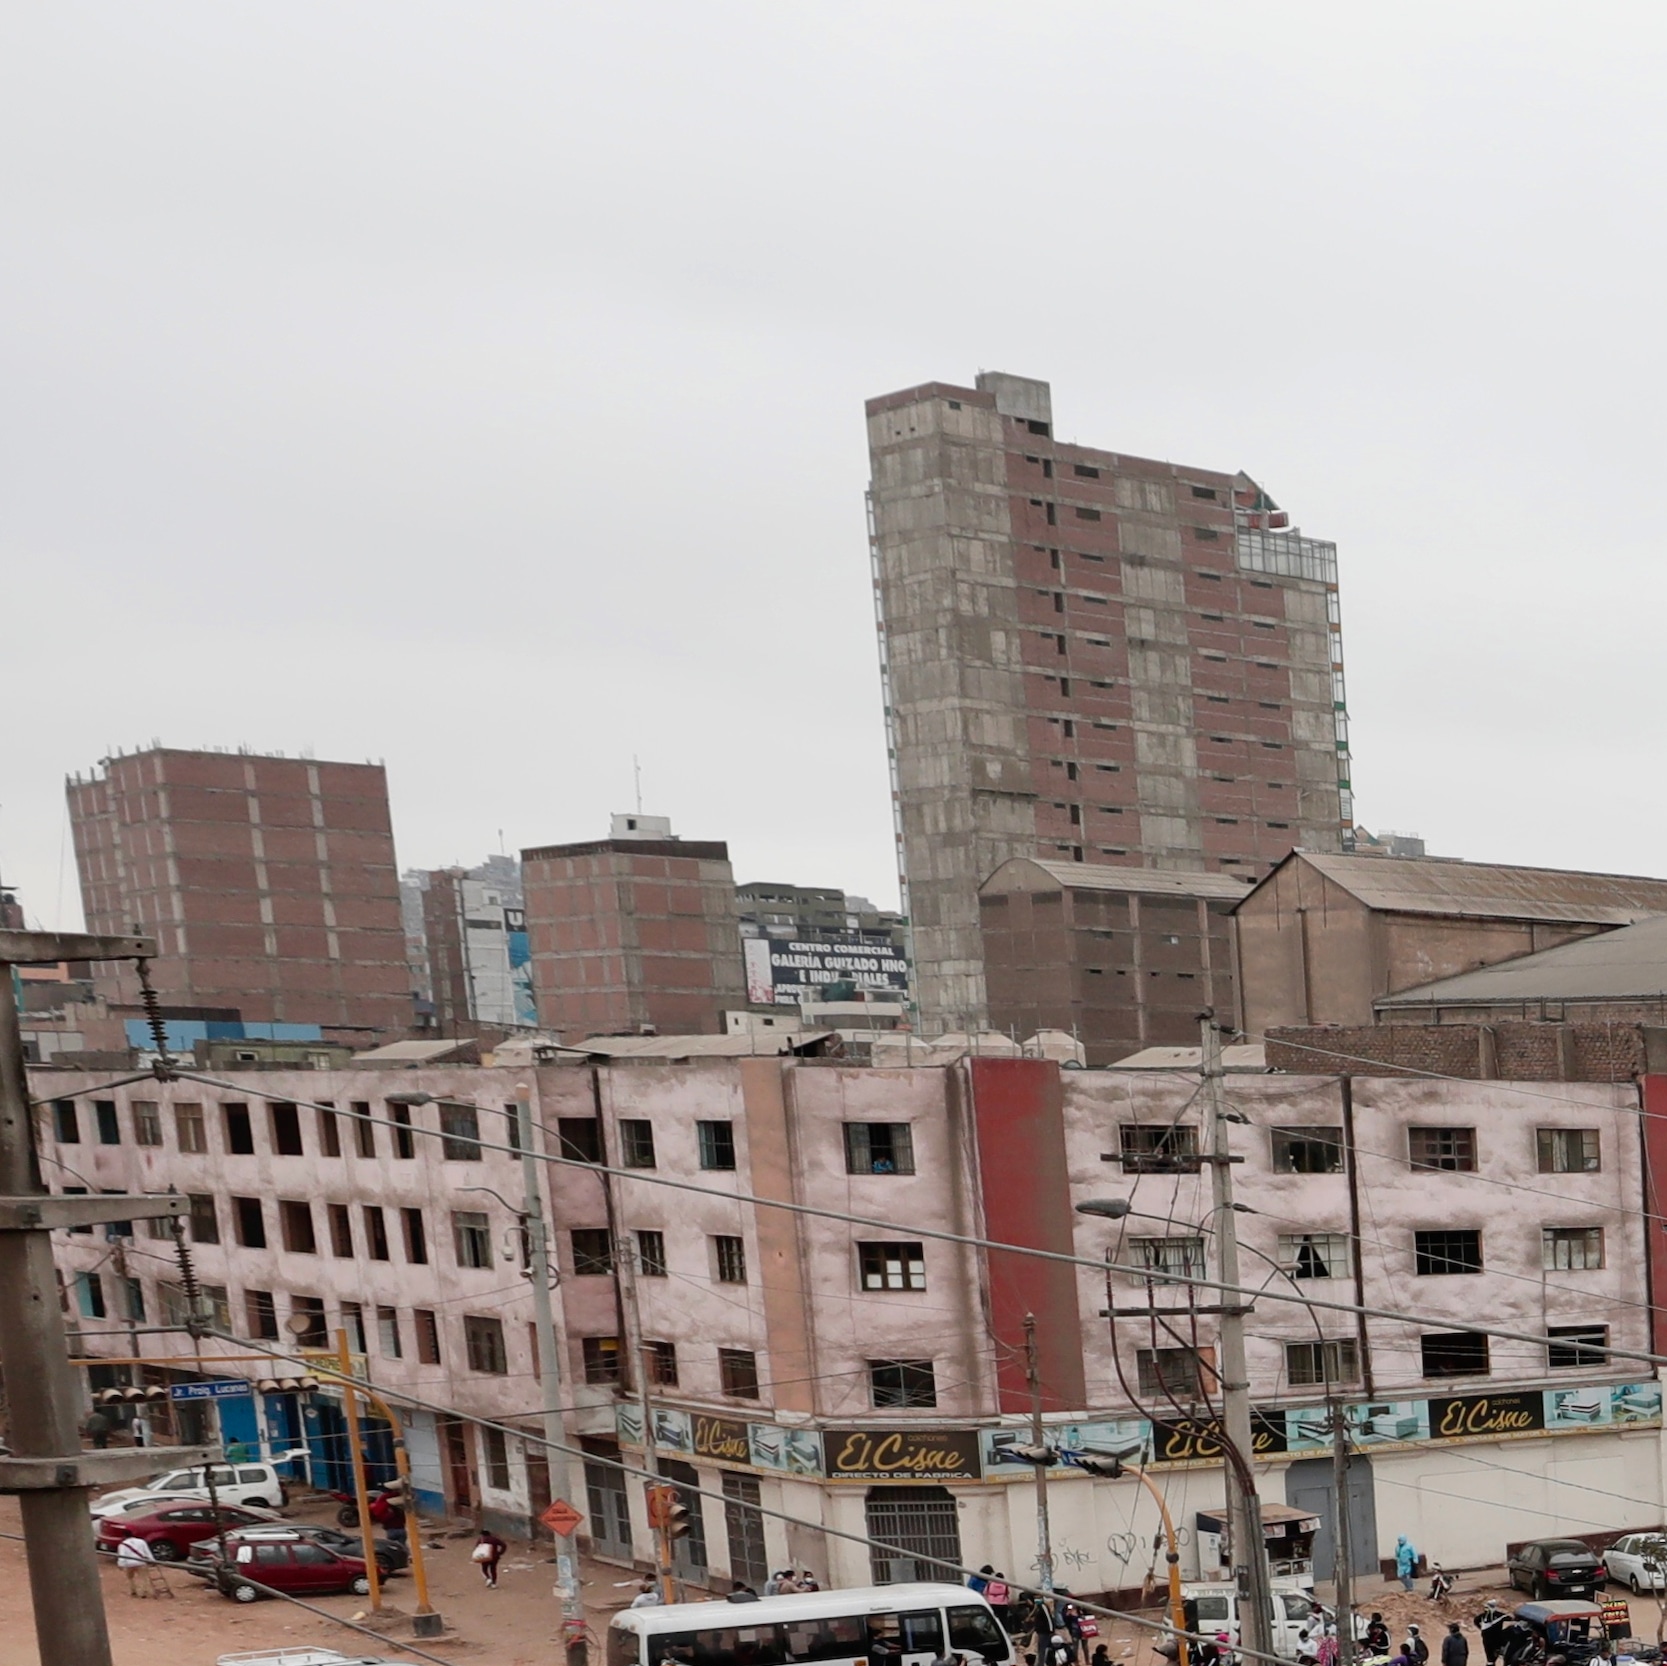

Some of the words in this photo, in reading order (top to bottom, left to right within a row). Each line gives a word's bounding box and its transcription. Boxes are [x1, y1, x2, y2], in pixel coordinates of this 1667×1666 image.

[788, 942, 832, 953] CENTRO
[834, 944, 895, 956] COMERCIAL
[824, 957, 878, 972] GUIZADO
[881, 958, 907, 973] HNO
[215, 1383, 249, 1394] Lucanas
[1440, 1401, 1466, 1435] El
[1467, 1400, 1533, 1432] Cisne
[695, 1417, 709, 1453] El
[837, 1433, 872, 1471] El
[873, 1433, 965, 1471] Cisne
[832, 1471, 889, 1479] DIRECTO
[893, 1471, 911, 1479] DE
[915, 1471, 973, 1479] FABRICA
